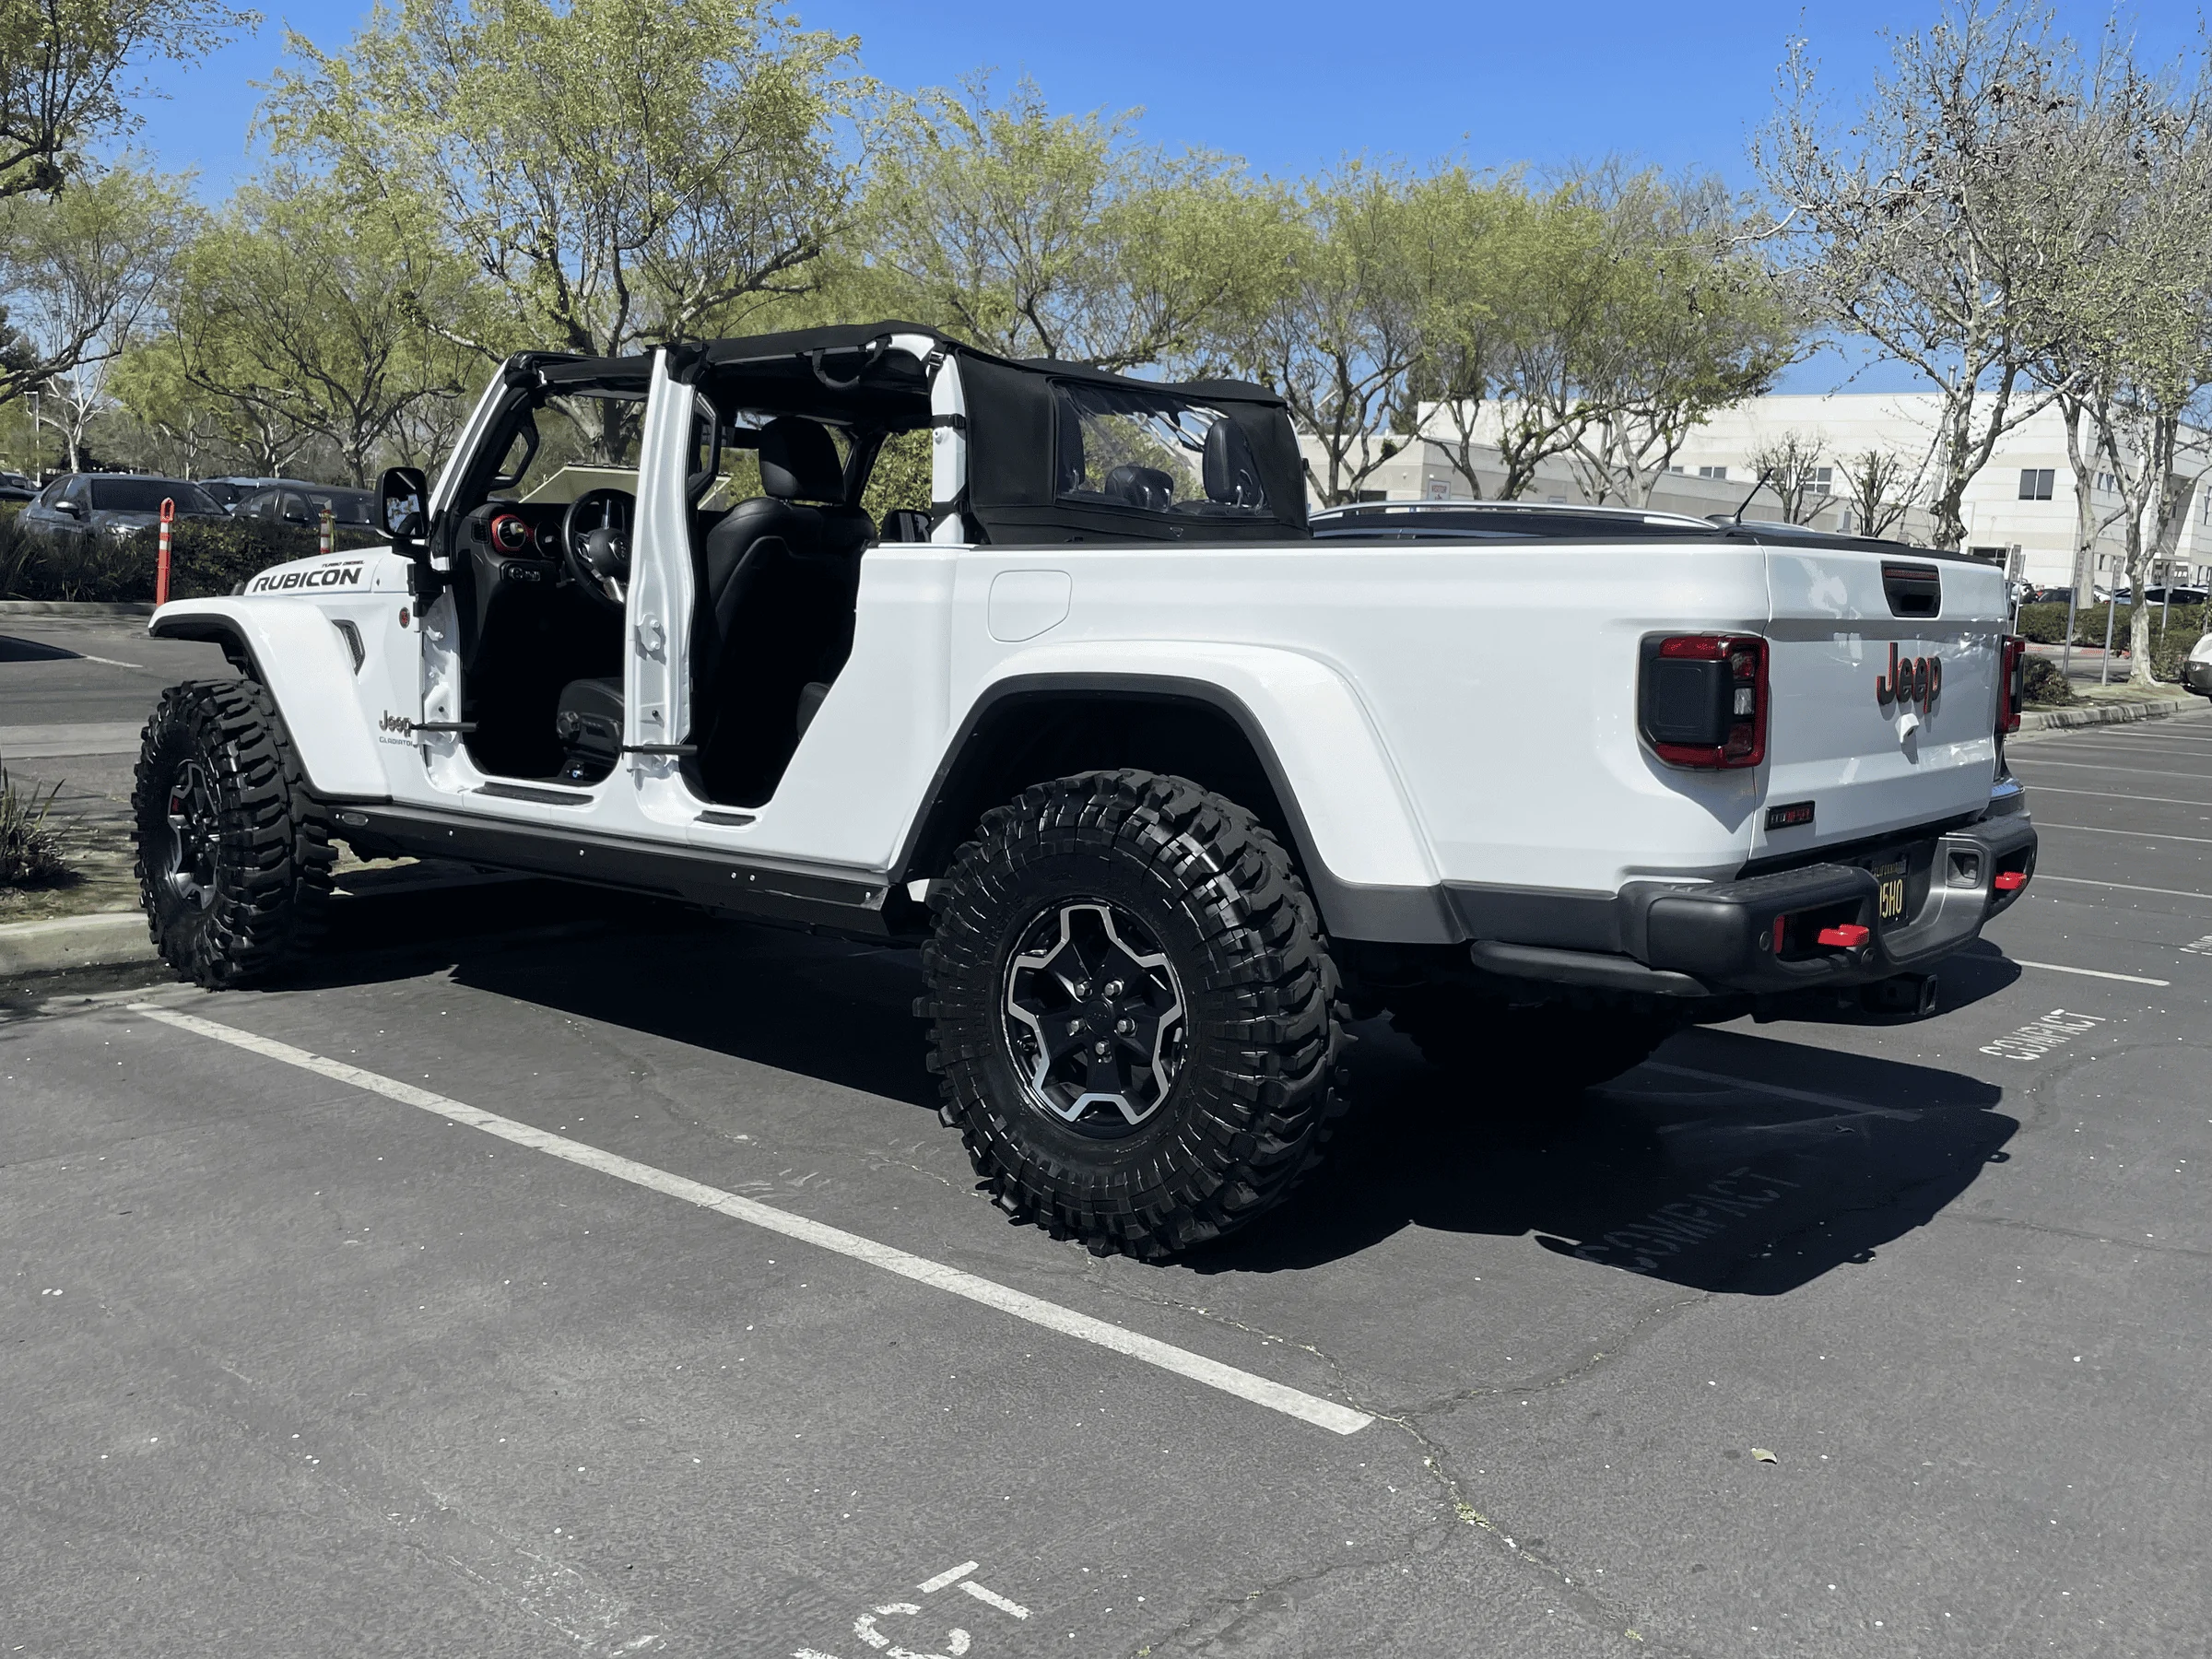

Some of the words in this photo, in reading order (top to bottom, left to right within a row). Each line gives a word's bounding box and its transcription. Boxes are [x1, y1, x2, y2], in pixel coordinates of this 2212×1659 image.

[252, 567, 362, 593] RUBICON
[1877, 641, 1941, 713] Jeep
[379, 710, 411, 738] Jeep
[1979, 1008, 2106, 1060] COMPACT
